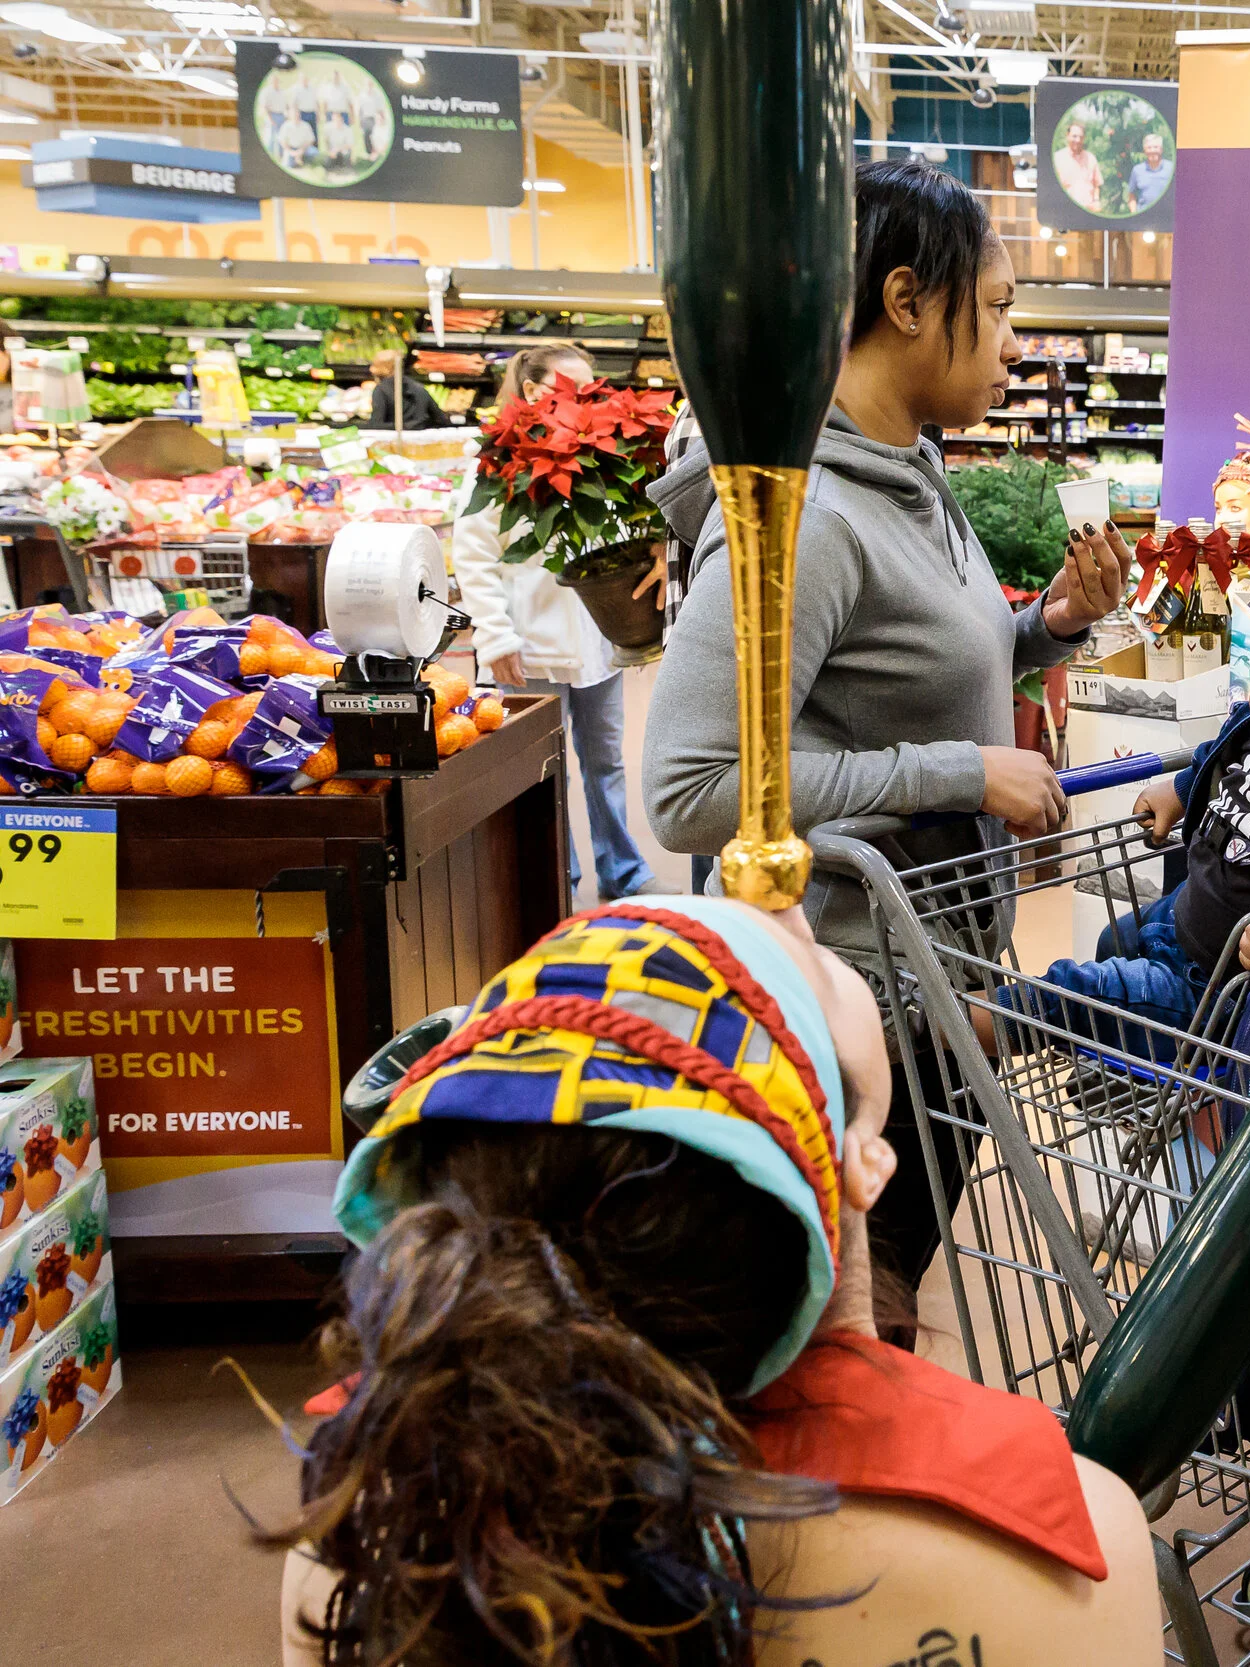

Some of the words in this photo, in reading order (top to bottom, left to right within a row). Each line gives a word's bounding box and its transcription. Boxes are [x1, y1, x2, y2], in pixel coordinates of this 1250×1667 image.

[401, 94, 449, 115] Hardy
[450, 97, 500, 114] Farms
[131, 163, 236, 194] BEVERAGE
[331, 700, 365, 708] TWIST
[381, 700, 407, 708] EASE
[5, 813, 83, 828] EVERYONE
[73, 967, 144, 993] LET
[157, 966, 236, 993] THE
[94, 1052, 227, 1078] BEGIN.
[19, 1103, 57, 1135] Sunkist
[108, 1113, 157, 1133] FOR
[166, 1111, 290, 1132] EVERYONE
[31, 1222, 70, 1257] Sunkist
